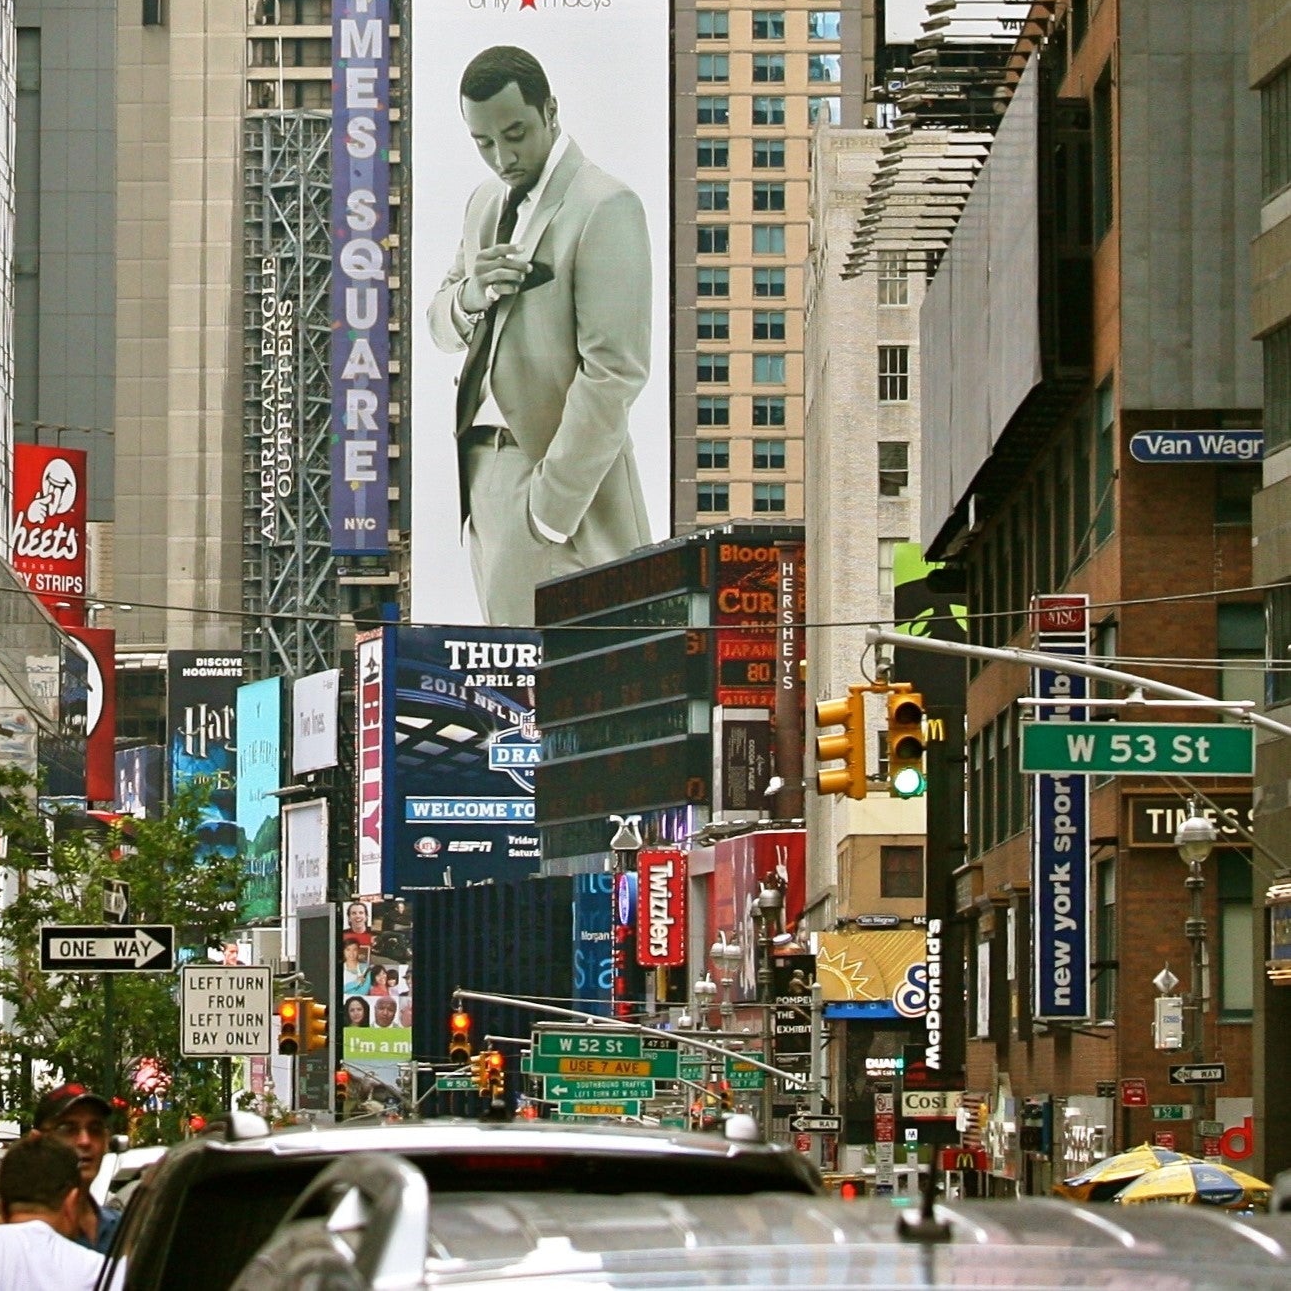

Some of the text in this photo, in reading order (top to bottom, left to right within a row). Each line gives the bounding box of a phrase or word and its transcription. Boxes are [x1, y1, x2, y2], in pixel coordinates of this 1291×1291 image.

[339, 191, 386, 482] SQUARE
[259, 257, 277, 543] AMERICAN EAGLE
[277, 299, 294, 498] OUTFITTERS
[1145, 435, 1192, 455] Van
[344, 517, 377, 530] NYC
[35, 573, 83, 594] STRIPS
[782, 562, 794, 690] HERSHEYS
[182, 667, 243, 677] HOGWARTS
[464, 674, 536, 687] APRIL 28
[420, 674, 507, 719] 2011 NFL
[1067, 734, 1210, 764] W 53 St
[412, 802, 535, 818] WELCOME TO
[447, 835, 539, 853] ESPN Friday
[1049, 861, 1077, 931] york
[648, 860, 675, 958] Twizzlers
[59, 940, 154, 958] ONE WAY
[1053, 940, 1072, 1007] new
[189, 976, 264, 991] LEFT TURN
[208, 995, 246, 1009] FROM
[925, 918, 943, 1071] McDonald's
[189, 1013, 264, 1027] LEFT TURN
[776, 1010, 795, 1020] THE
[192, 1031, 261, 1045] BAY ONLY
[349, 1037, 392, 1054] I'm a
[559, 1038, 624, 1053] W 52 St
[569, 1061, 641, 1074] USE 7 AVE
